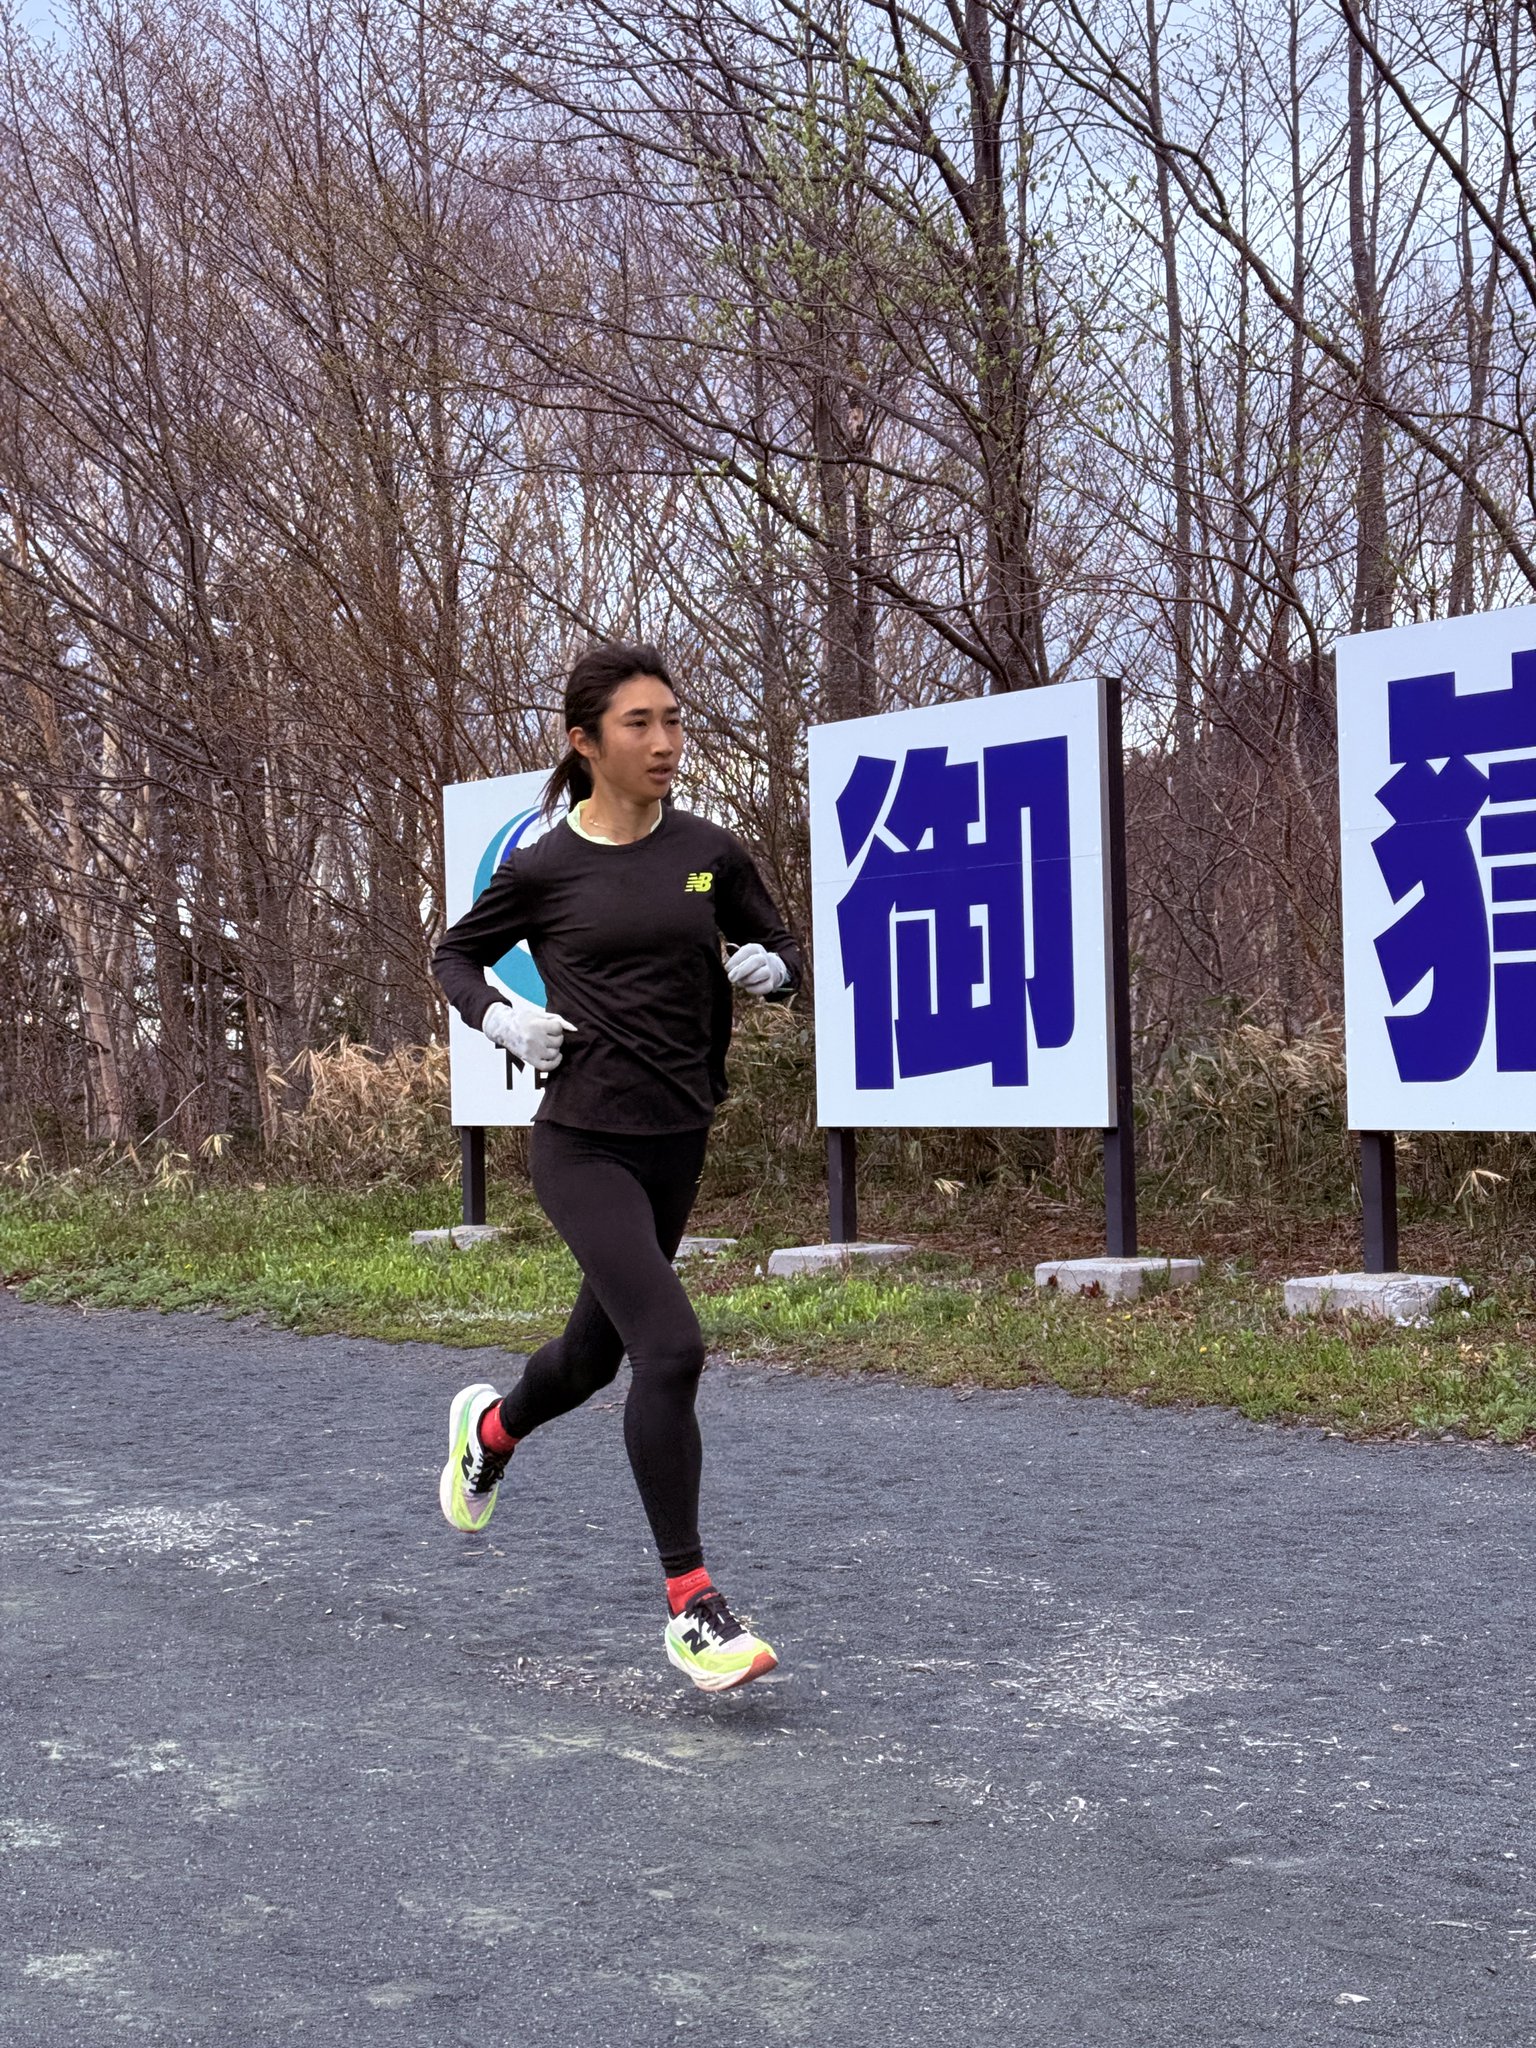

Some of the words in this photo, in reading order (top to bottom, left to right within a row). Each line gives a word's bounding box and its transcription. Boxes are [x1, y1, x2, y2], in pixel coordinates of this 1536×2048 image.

[684, 872, 713, 892] NB
[836, 735, 1075, 1090] 御
[461, 1442, 474, 1480] N
[681, 1627, 710, 1655] N
